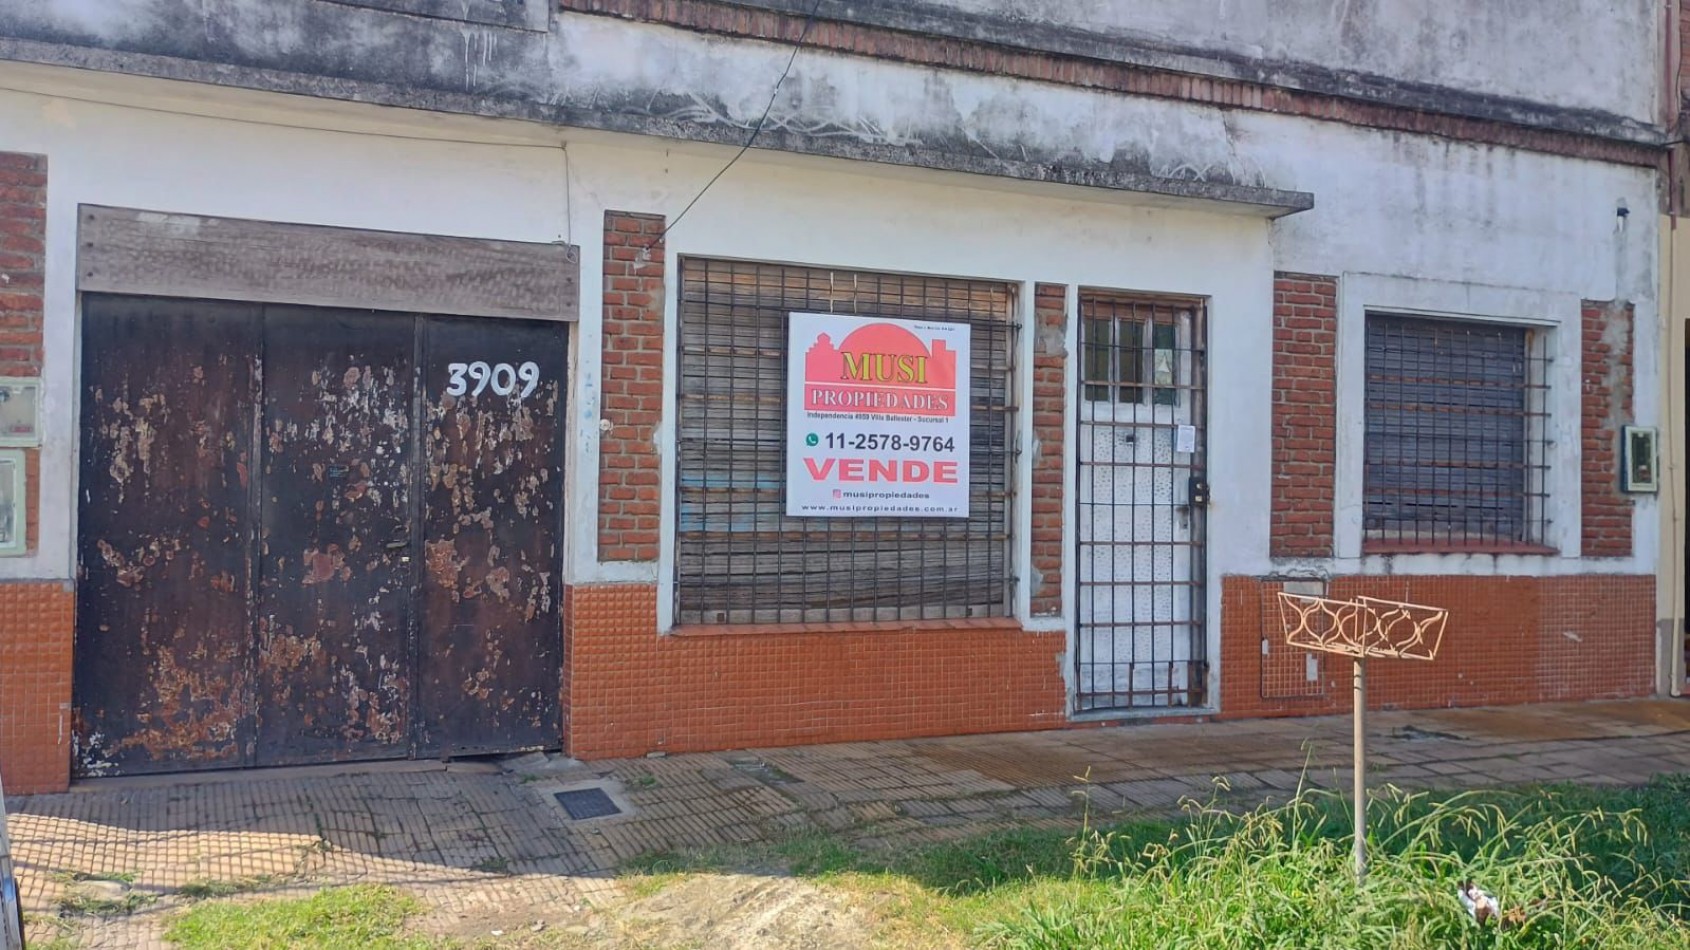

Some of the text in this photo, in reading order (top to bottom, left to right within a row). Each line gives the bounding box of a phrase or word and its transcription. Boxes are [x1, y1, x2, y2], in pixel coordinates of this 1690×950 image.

[840, 351, 928, 384] MUSI
[446, 361, 540, 398] 3909
[811, 388, 948, 410] PROPIEDADES
[807, 411, 853, 420] Independencia
[871, 413, 884, 421] Villa
[886, 414, 912, 422] Ballester
[918, 415, 944, 423] Sucursal
[825, 432, 955, 452] 11-2578-9764
[803, 457, 958, 484] VENDE
[842, 490, 930, 500] musipropiedades
[801, 503, 959, 512] www.musipropiedades.com.ar
